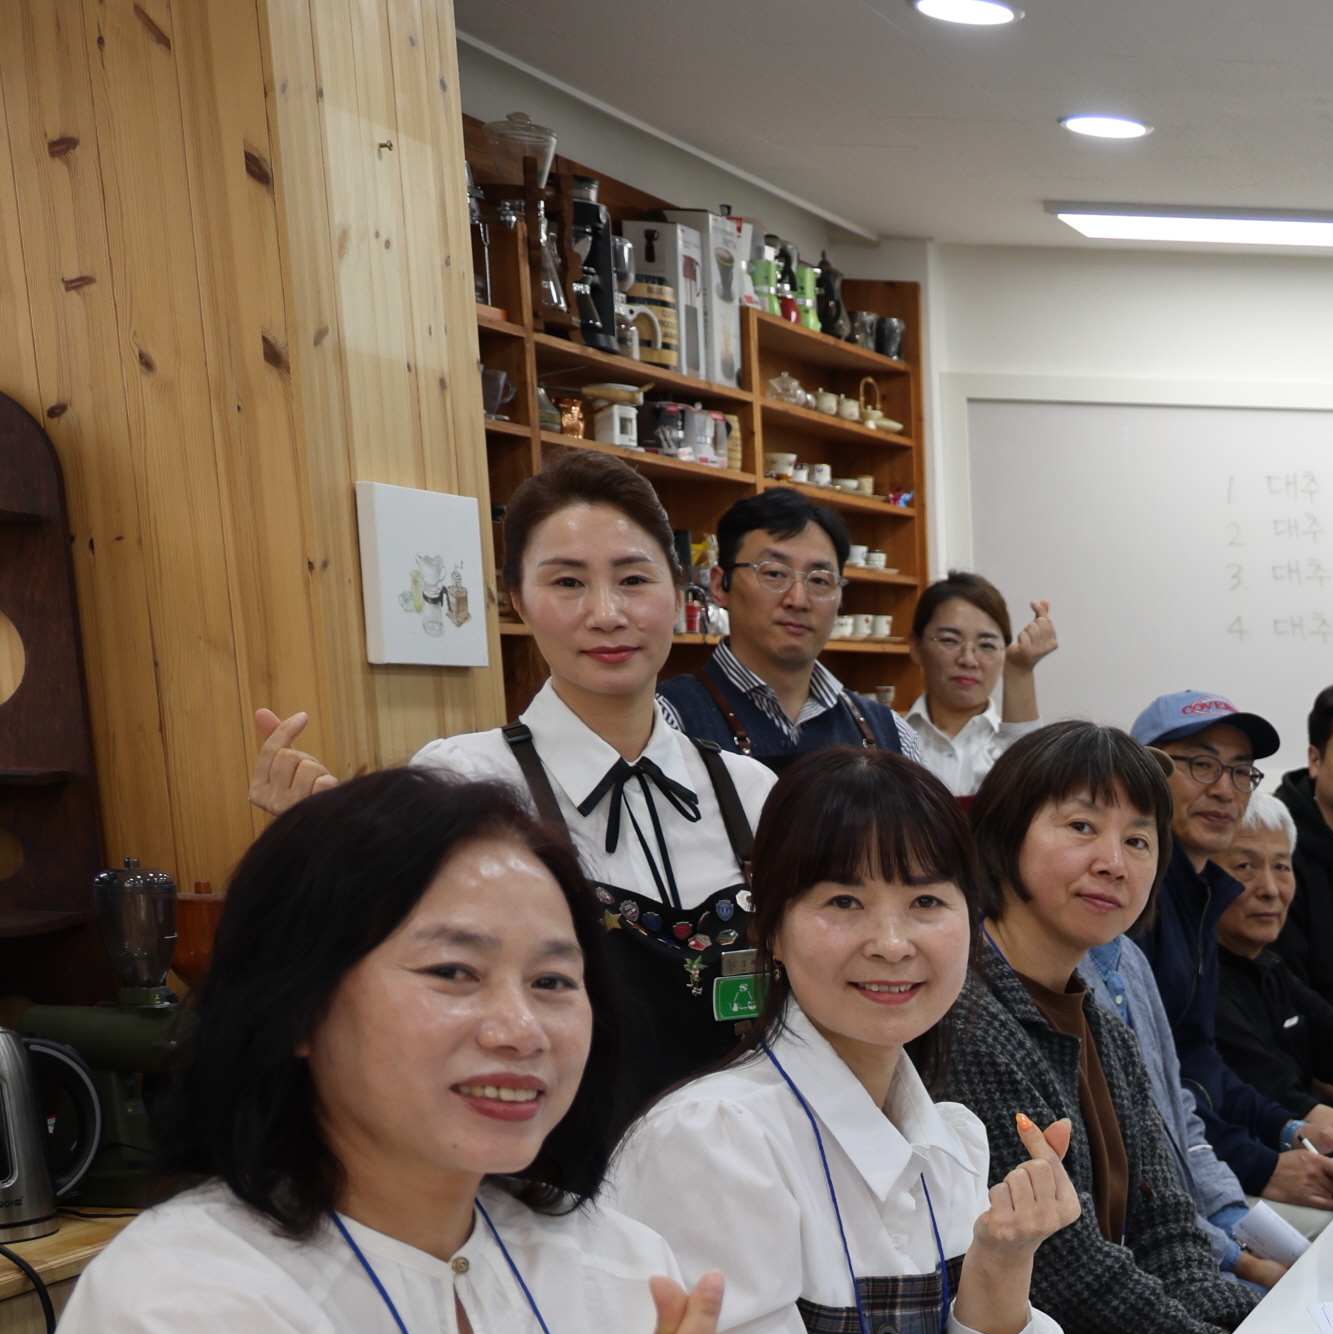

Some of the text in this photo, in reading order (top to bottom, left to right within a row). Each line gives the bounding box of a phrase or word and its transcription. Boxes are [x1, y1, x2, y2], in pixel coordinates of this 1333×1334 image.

[1266, 471, 1319, 502] 대추
[1273, 512, 1324, 543] 대추
[1271, 558, 1331, 586] 대추
[1273, 612, 1333, 644] 대추
